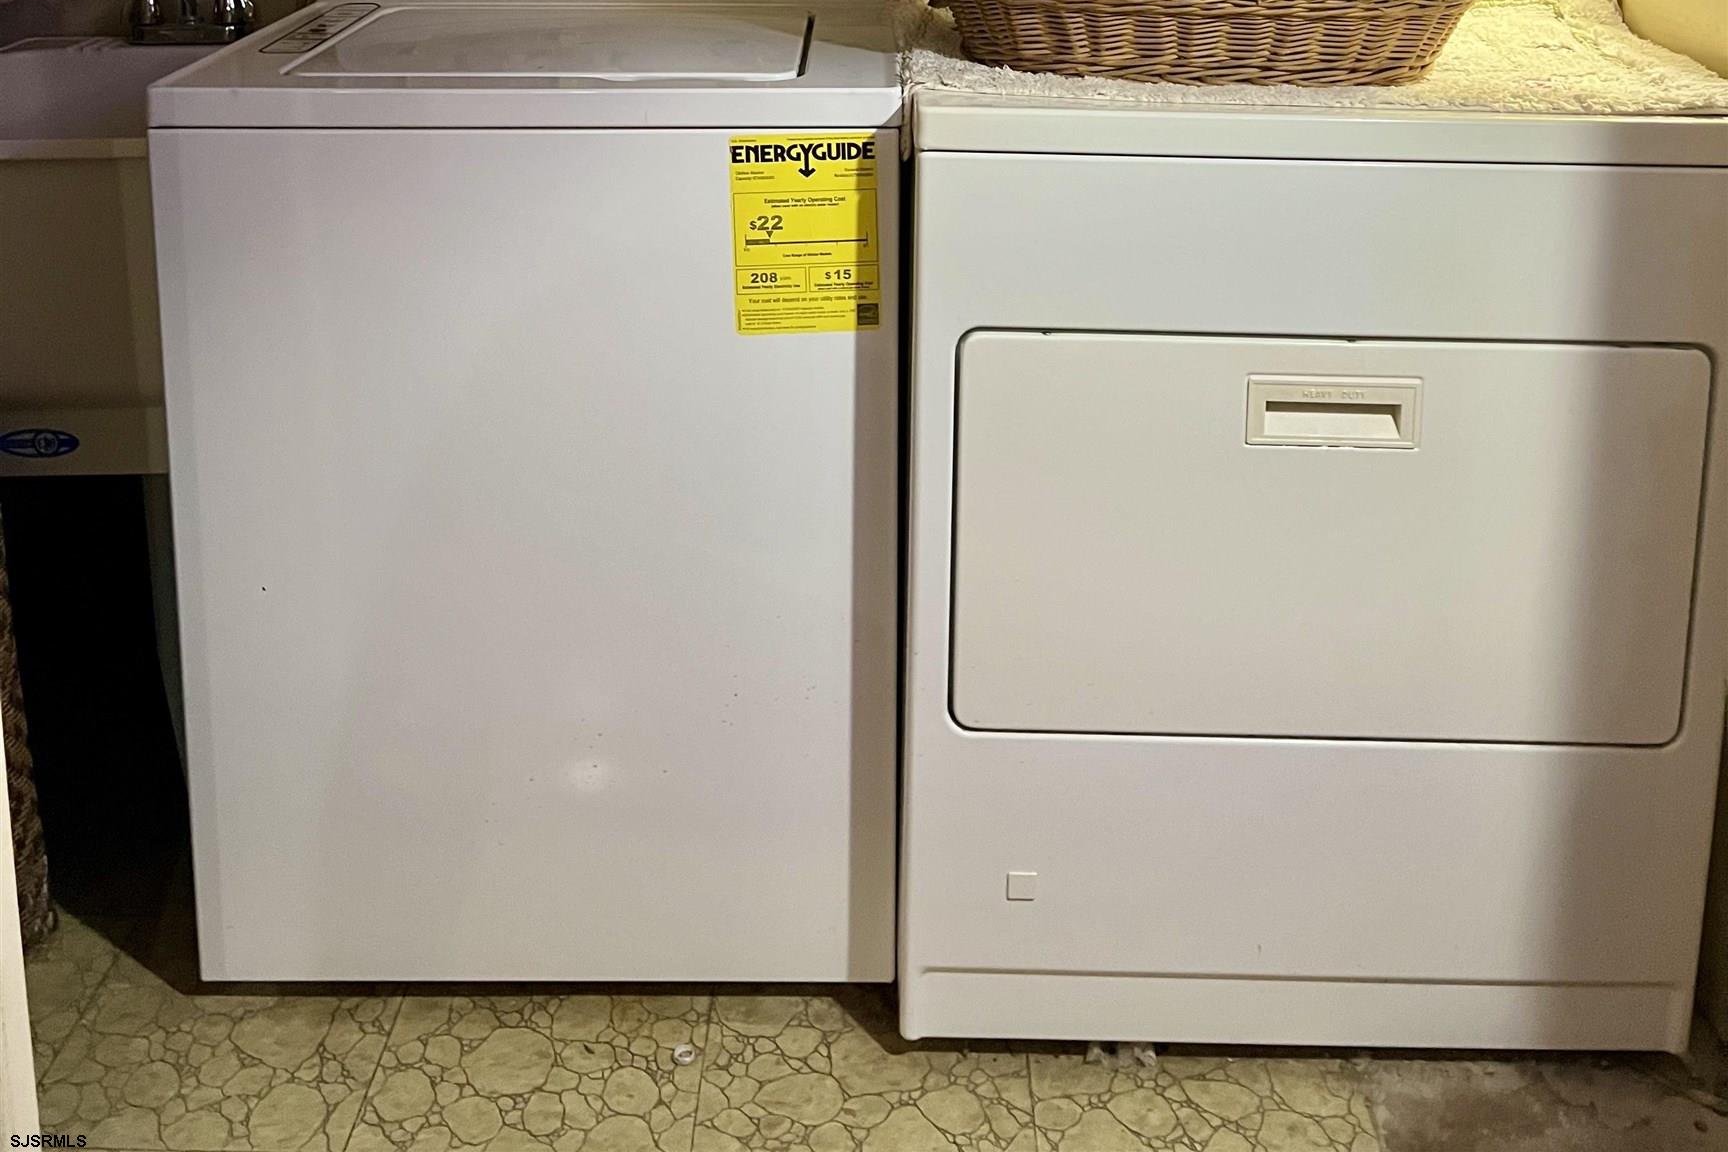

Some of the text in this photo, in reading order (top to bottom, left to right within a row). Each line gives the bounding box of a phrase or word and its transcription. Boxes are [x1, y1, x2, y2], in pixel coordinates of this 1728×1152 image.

[731, 142, 876, 165] ENERGYGUIDE
[749, 215, 783, 231] $22
[750, 272, 778, 284] 208
